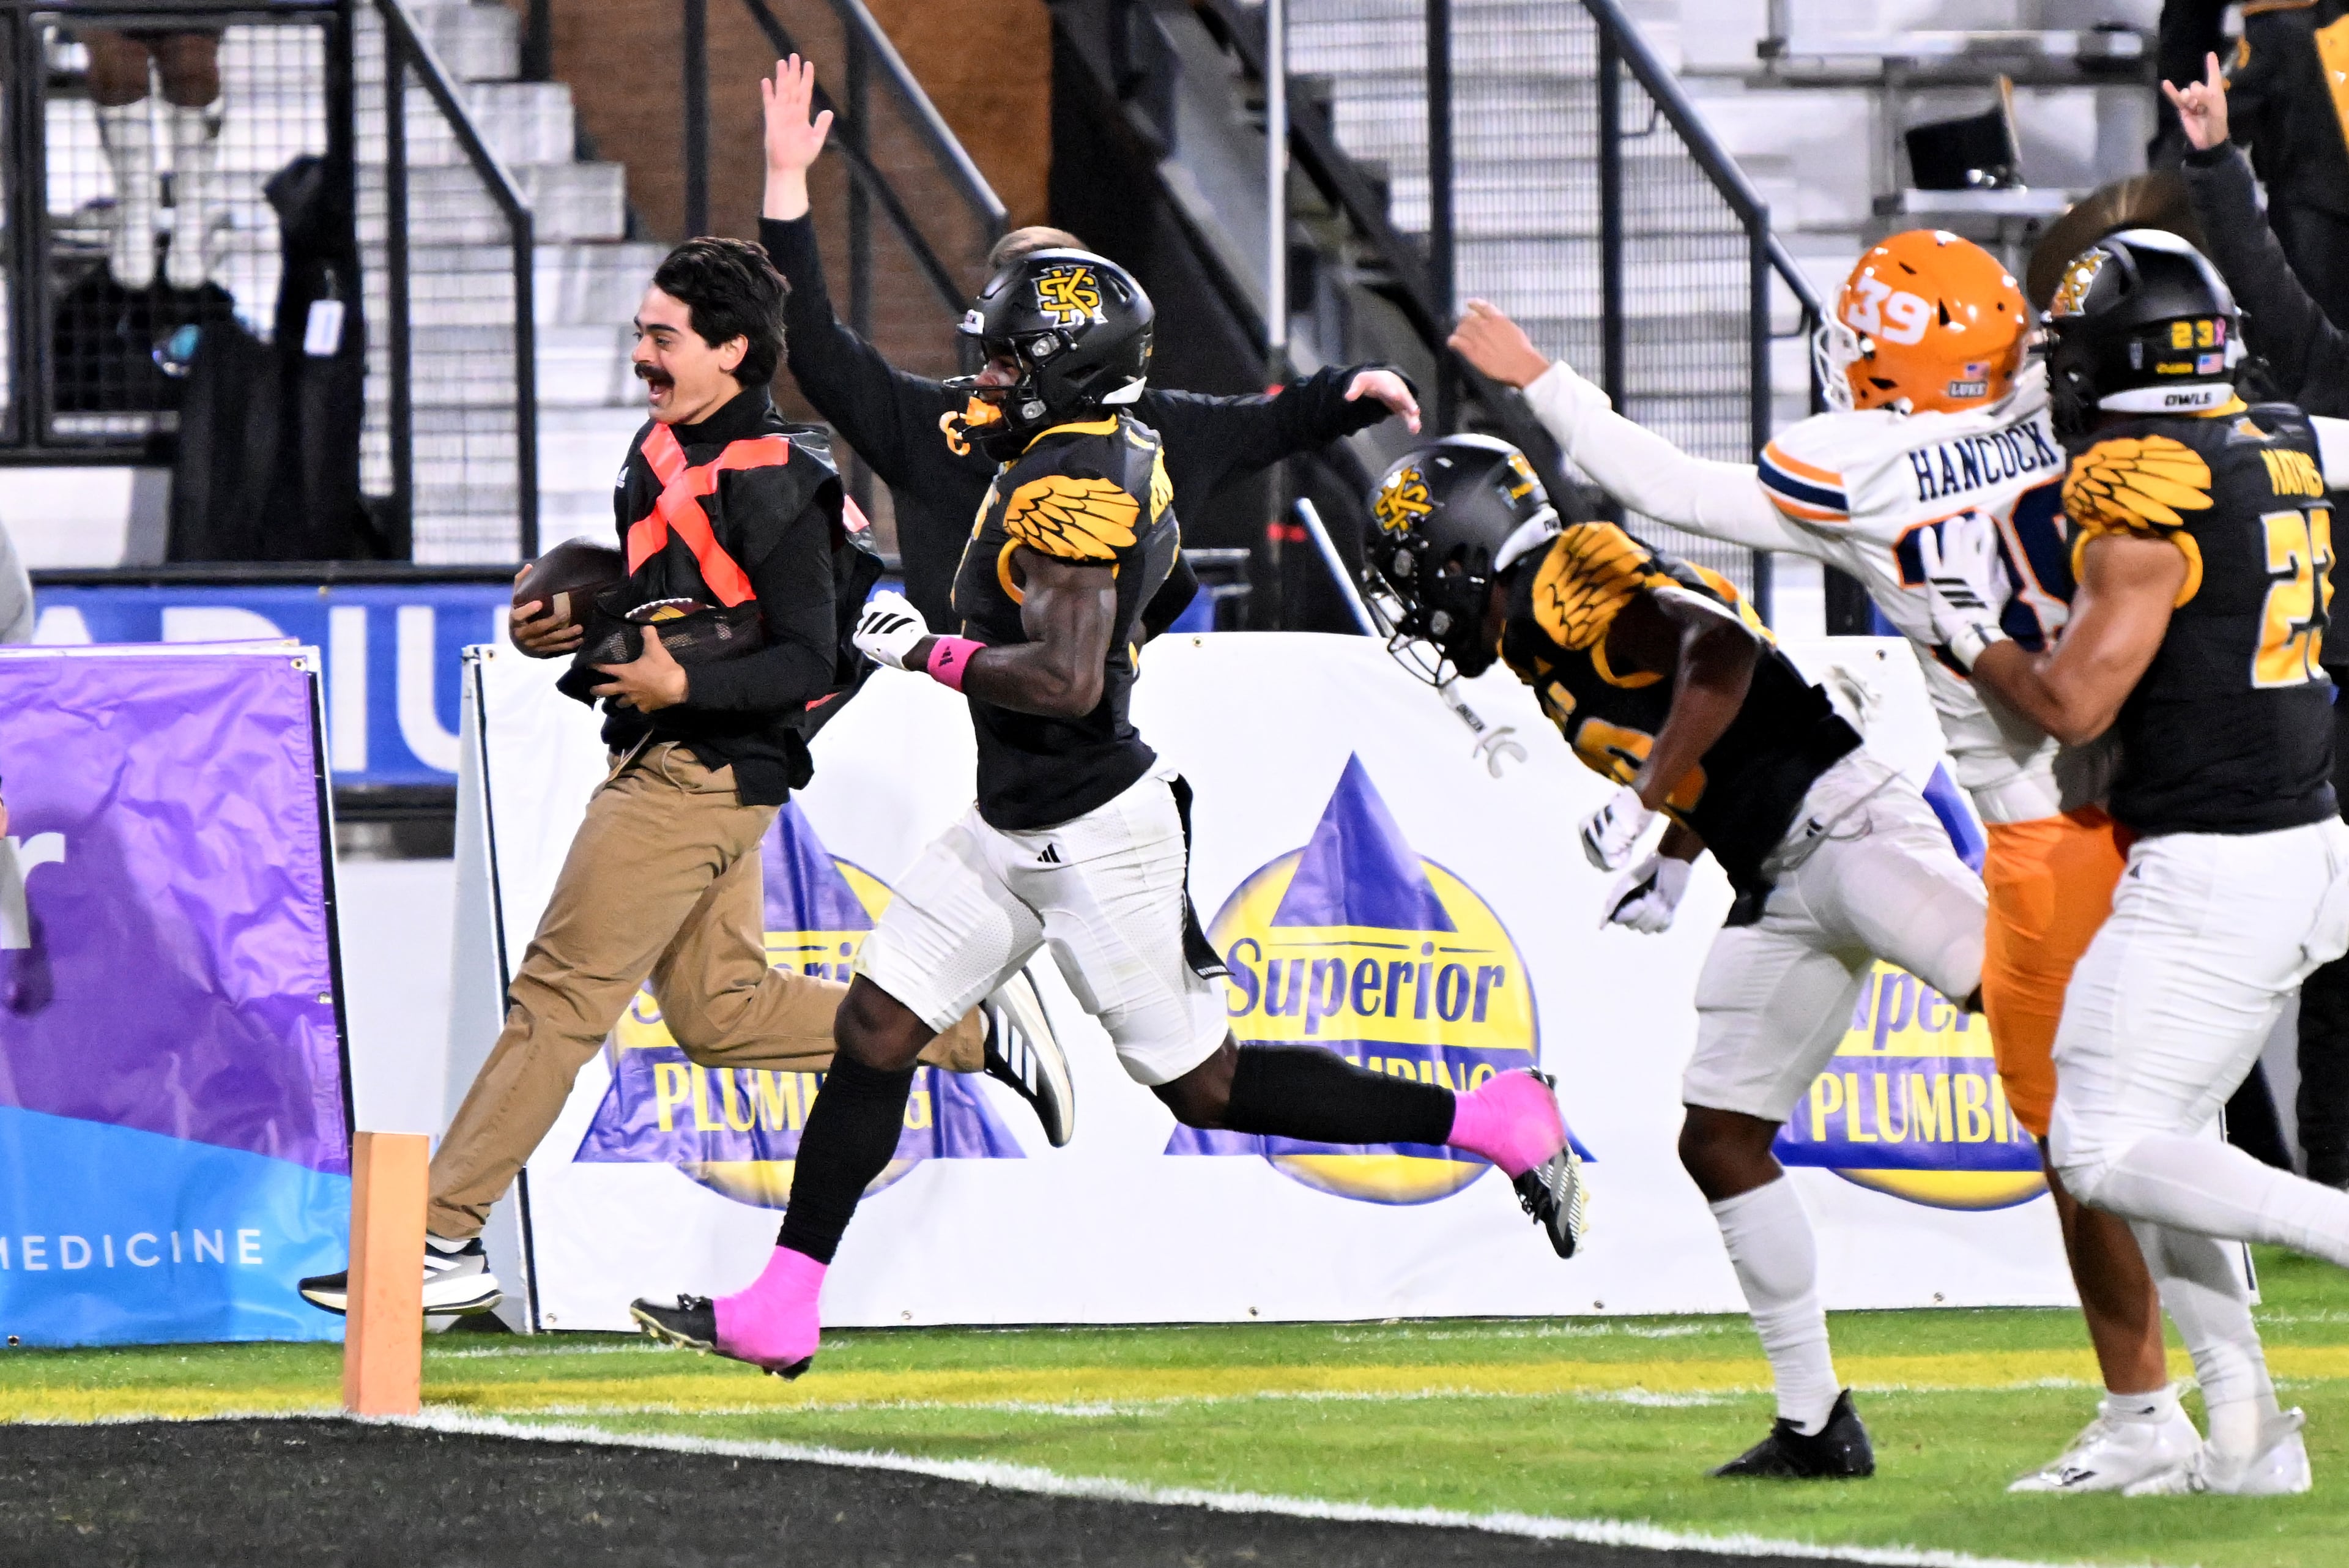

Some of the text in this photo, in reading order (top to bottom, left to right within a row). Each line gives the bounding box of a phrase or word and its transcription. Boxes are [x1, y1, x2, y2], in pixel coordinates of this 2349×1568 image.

[1847, 275, 1931, 345] 39
[2171, 319, 2214, 349] 23
[2164, 393, 2213, 406] OWLS
[1909, 420, 2058, 502] HANCOCK
[1225, 937, 1505, 1035] Superior
